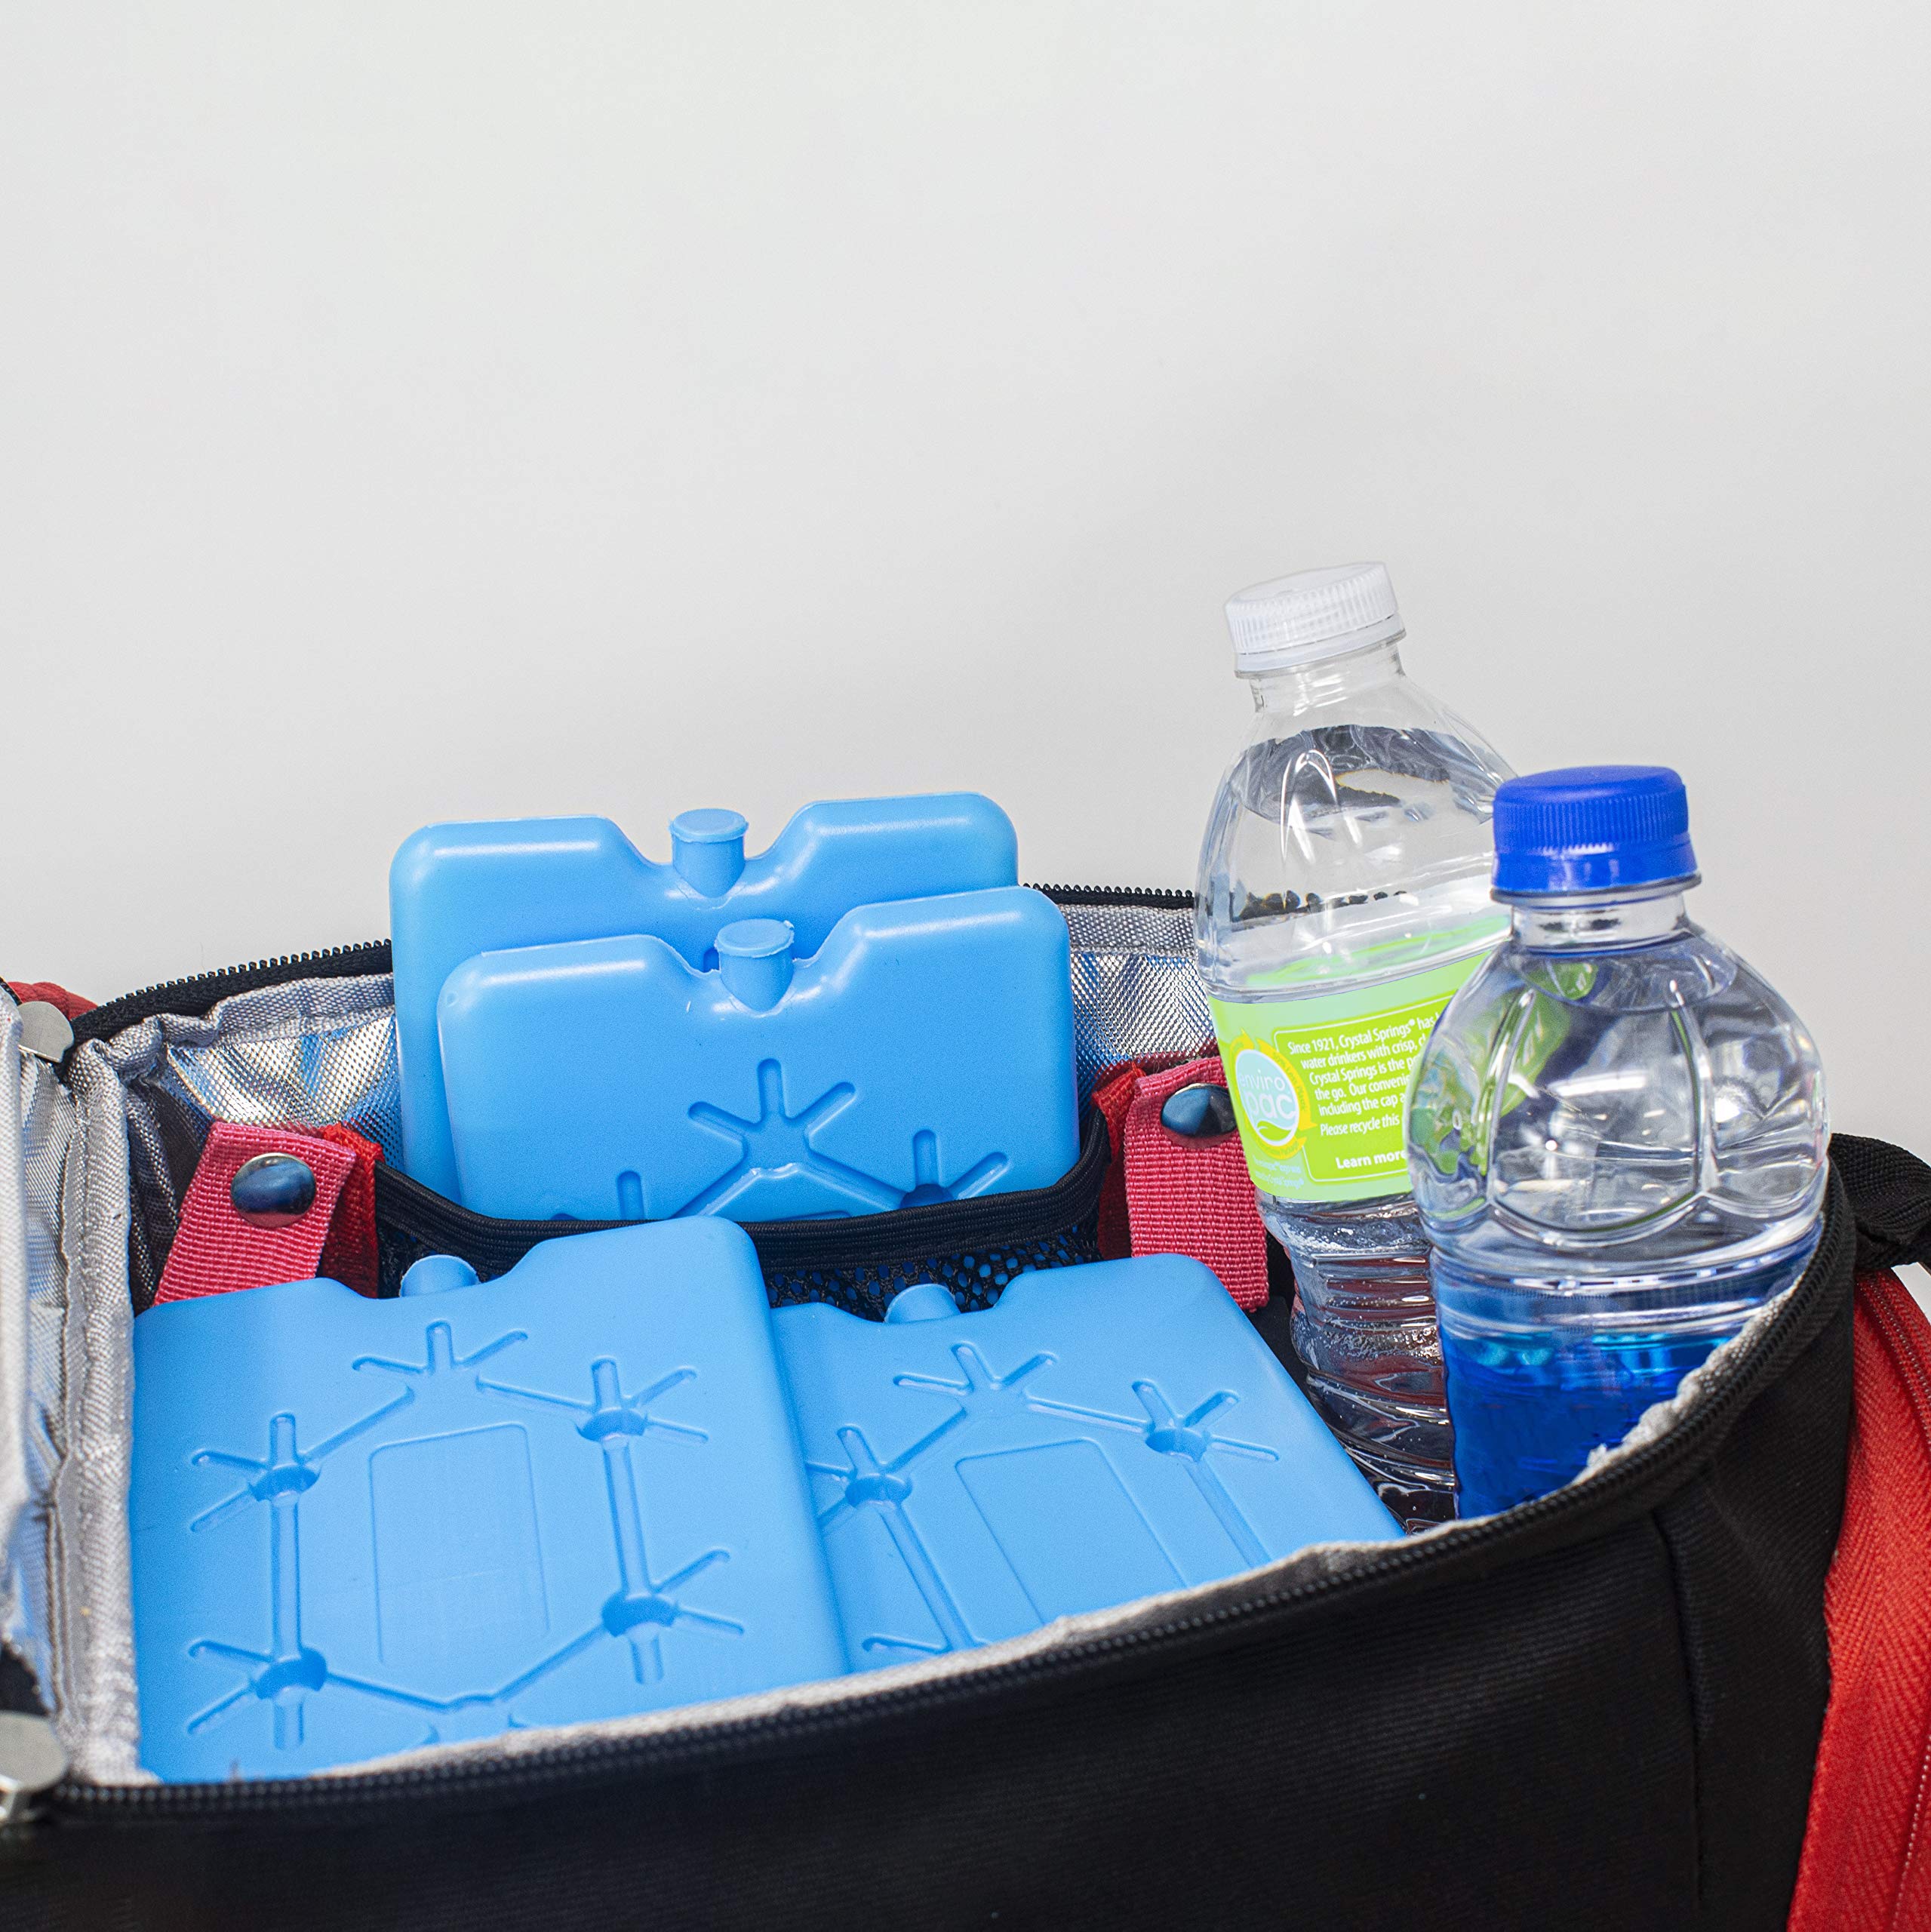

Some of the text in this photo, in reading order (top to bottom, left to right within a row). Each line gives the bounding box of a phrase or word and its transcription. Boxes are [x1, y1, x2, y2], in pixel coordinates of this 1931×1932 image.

[1287, 1041, 1311, 1055] Since
[1311, 1037, 1339, 1052] 1921,
[1339, 1029, 1373, 1050] Crystal
[1416, 1017, 1435, 1030] has
[1300, 1057, 1327, 1069] water
[1328, 1051, 1367, 1066] drinkers
[1367, 1043, 1391, 1059] with
[1391, 1039, 1418, 1054] crisp,
[1238, 1069, 1286, 1091] enviro
[1309, 1069, 1341, 1087] Crystal
[1339, 1065, 1378, 1082] Springs
[1377, 1061, 1387, 1074] is
[1387, 1057, 1405, 1072] the
[1314, 1088, 1330, 1100] the
[1331, 1088, 1347, 1102] go.
[1348, 1083, 1367, 1097] Our
[1244, 1091, 1297, 1120] pac
[1318, 1100, 1361, 1116] including
[1362, 1097, 1379, 1110] the
[1380, 1094, 1398, 1108] cap
[1320, 1113, 1400, 1136] Please recycle this
[1335, 1149, 1408, 1169] Learn more
